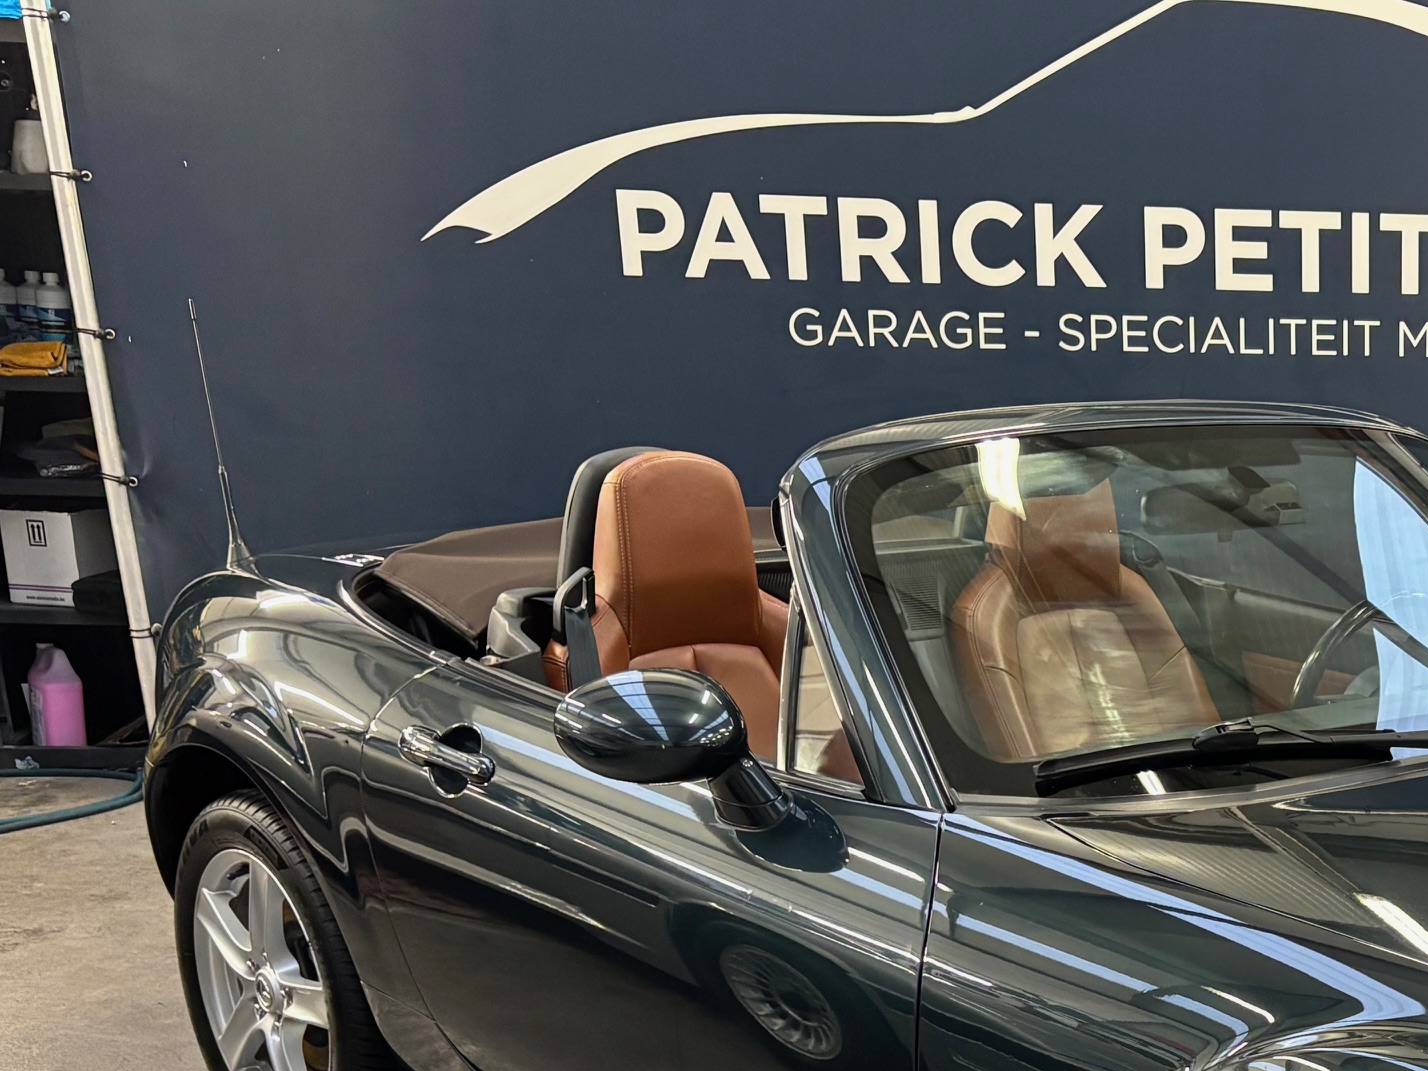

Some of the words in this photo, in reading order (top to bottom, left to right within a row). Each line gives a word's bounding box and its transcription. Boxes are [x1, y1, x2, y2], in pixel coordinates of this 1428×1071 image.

[615, 188, 1107, 288] PATRICK
[788, 307, 1007, 350] GARAGE
[1058, 313, 1381, 357] SPECIALITEIT
